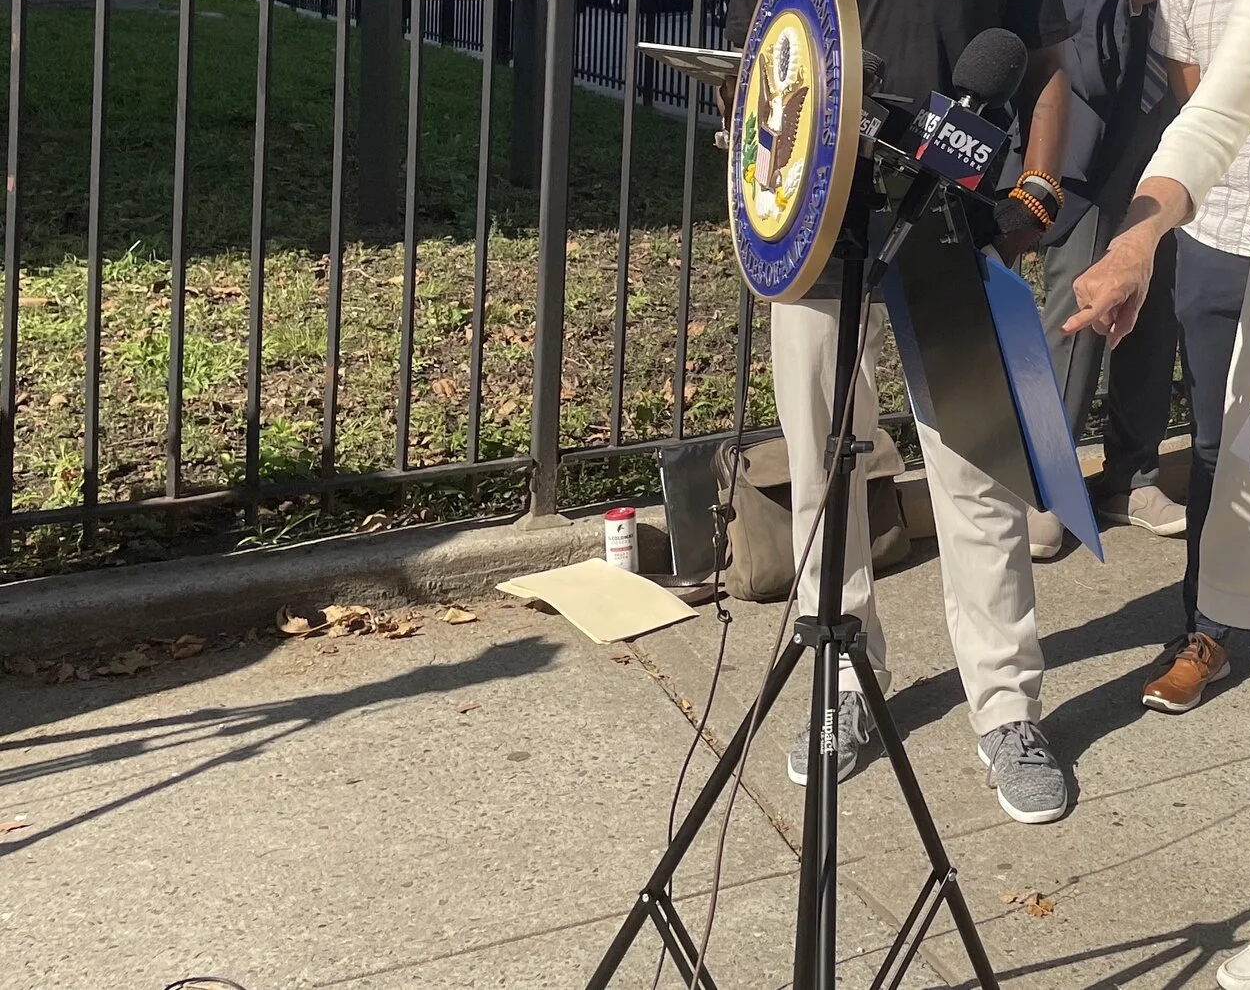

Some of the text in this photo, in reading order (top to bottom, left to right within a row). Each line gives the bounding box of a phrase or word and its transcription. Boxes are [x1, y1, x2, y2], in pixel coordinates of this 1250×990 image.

[933, 139, 983, 172] NEW YORK
[822, 708, 836, 753] impact
